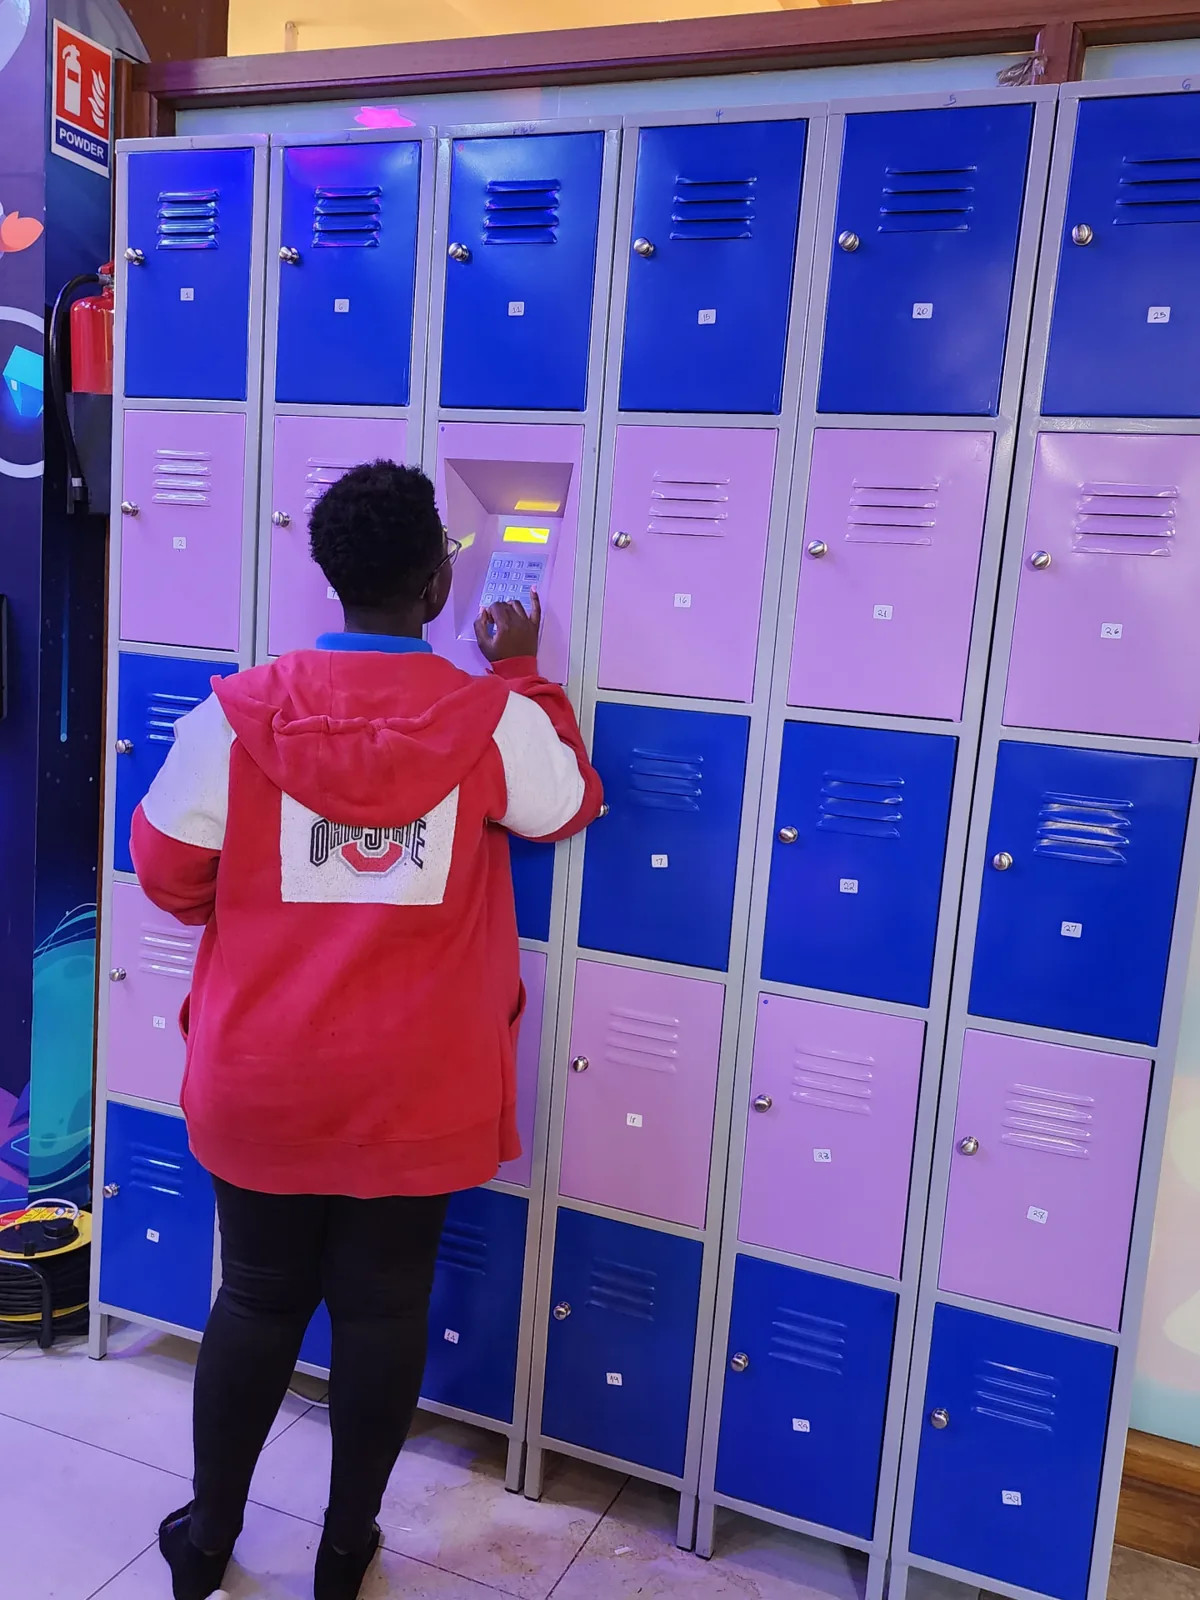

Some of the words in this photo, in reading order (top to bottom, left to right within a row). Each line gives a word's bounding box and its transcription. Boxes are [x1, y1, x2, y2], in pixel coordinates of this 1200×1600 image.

[59, 127, 104, 159] POWDER
[512, 306, 522, 314] 11
[916, 307, 929, 316] 20
[702, 313, 711, 322] 15
[1152, 311, 1167, 320] 25
[678, 595, 687, 604] 16
[877, 609, 887, 618] 21
[1104, 627, 1120, 635] 26
[843, 881, 855, 891] 22
[1064, 924, 1077, 932] 27
[156, 1019, 163, 1027] 4
[818, 1151, 830, 1160] 23
